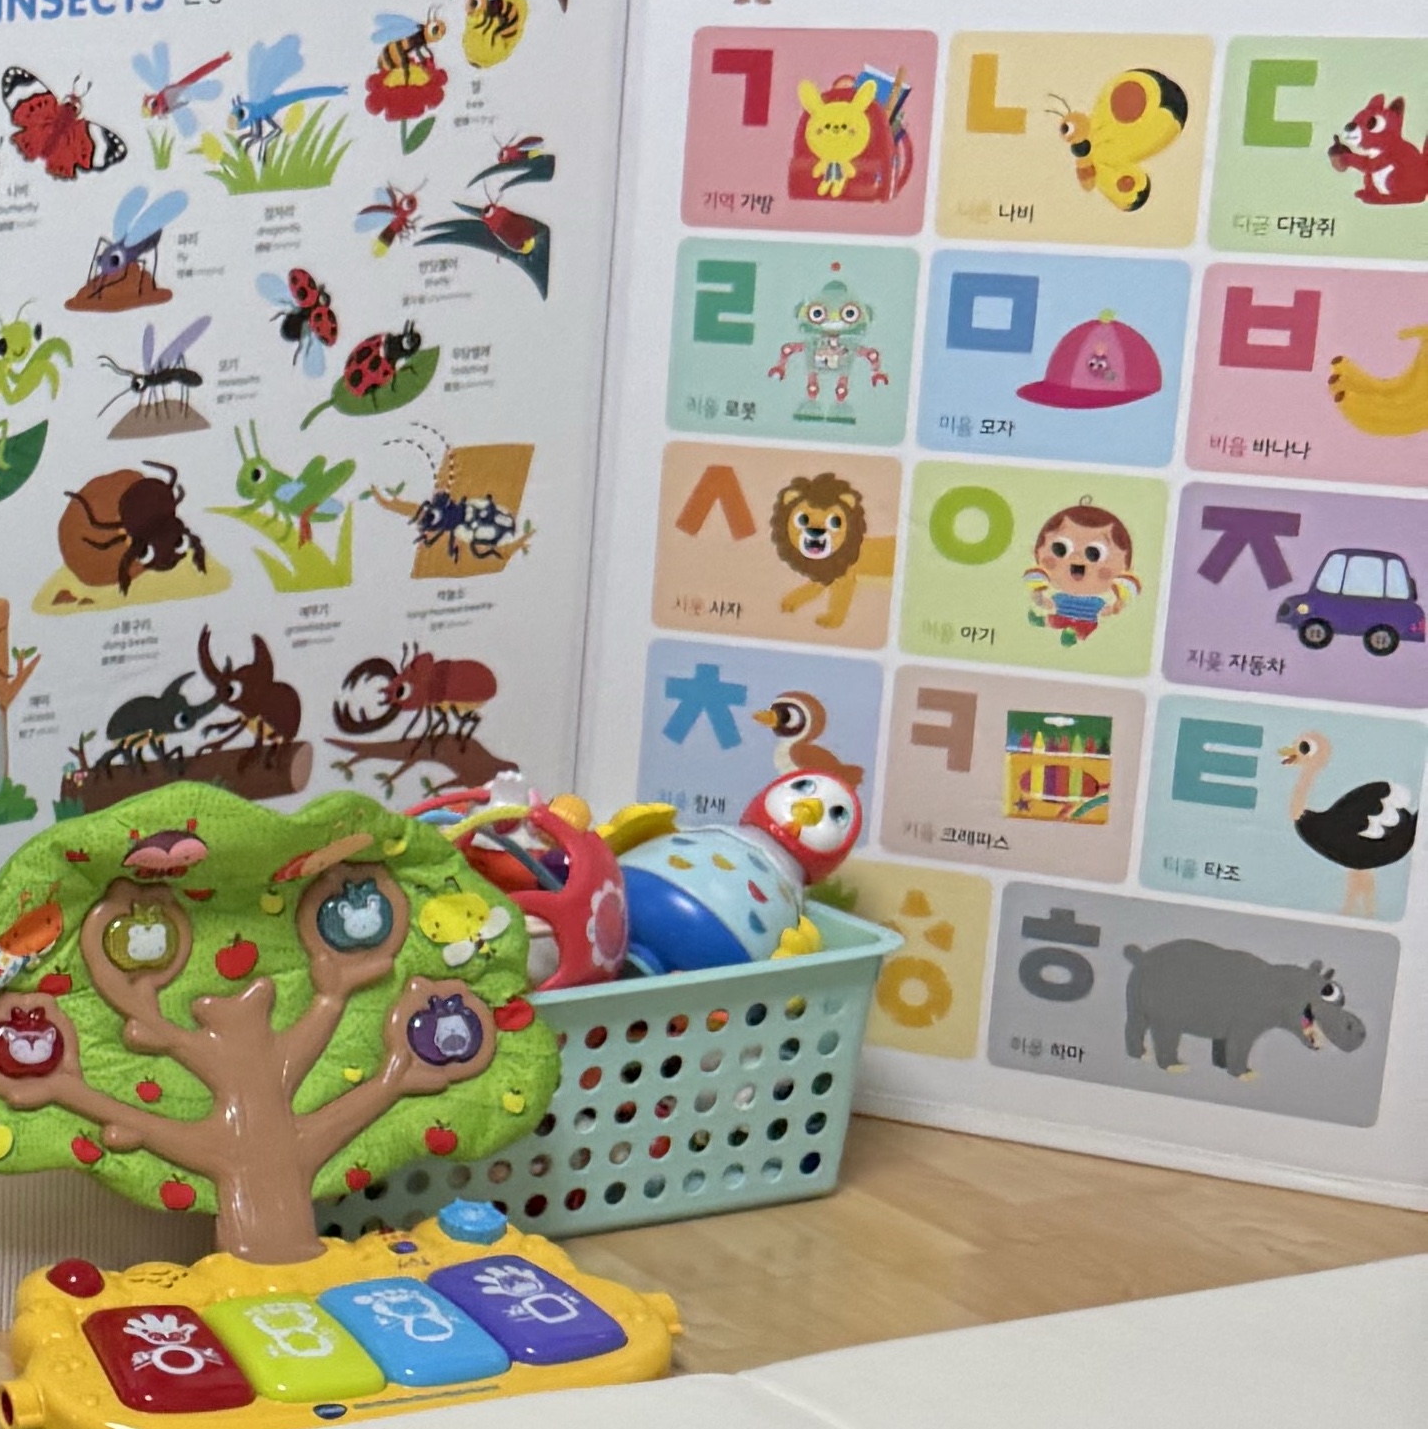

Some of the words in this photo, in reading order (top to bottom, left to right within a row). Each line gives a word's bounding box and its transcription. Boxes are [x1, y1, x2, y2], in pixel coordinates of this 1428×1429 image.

[712, 48, 774, 127] ㄱ
[966, 53, 1028, 134] ㄴ
[1243, 59, 1318, 148] ㄷ
[740, 193, 775, 215] 가방
[998, 203, 1035, 224] 나비
[1277, 215, 1336, 239] 다람쥐
[694, 259, 757, 346] ㄹ
[947, 271, 1040, 354] ㅁ
[1218, 286, 1322, 372] ㅂ
[978, 418, 1016, 438] 모자
[1252, 438, 1312, 460] 바나나
[675, 464, 757, 541] ㅅ
[929, 485, 1015, 566] ㅇ
[1197, 505, 1302, 591] ㅈ
[708, 598, 742, 620] 사자
[959, 625, 995, 645] 아기
[1228, 654, 1287, 677] 자동차
[662, 663, 748, 750] ㅊ
[910, 686, 978, 773] ㅋ
[1172, 717, 1264, 810] ㅌ
[694, 794, 726, 815] 참새
[939, 826, 1010, 850] 크레파스
[1204, 861, 1242, 882] 타조
[1018, 907, 1102, 1002] ㅎ
[1050, 1041, 1086, 1063] 하마
